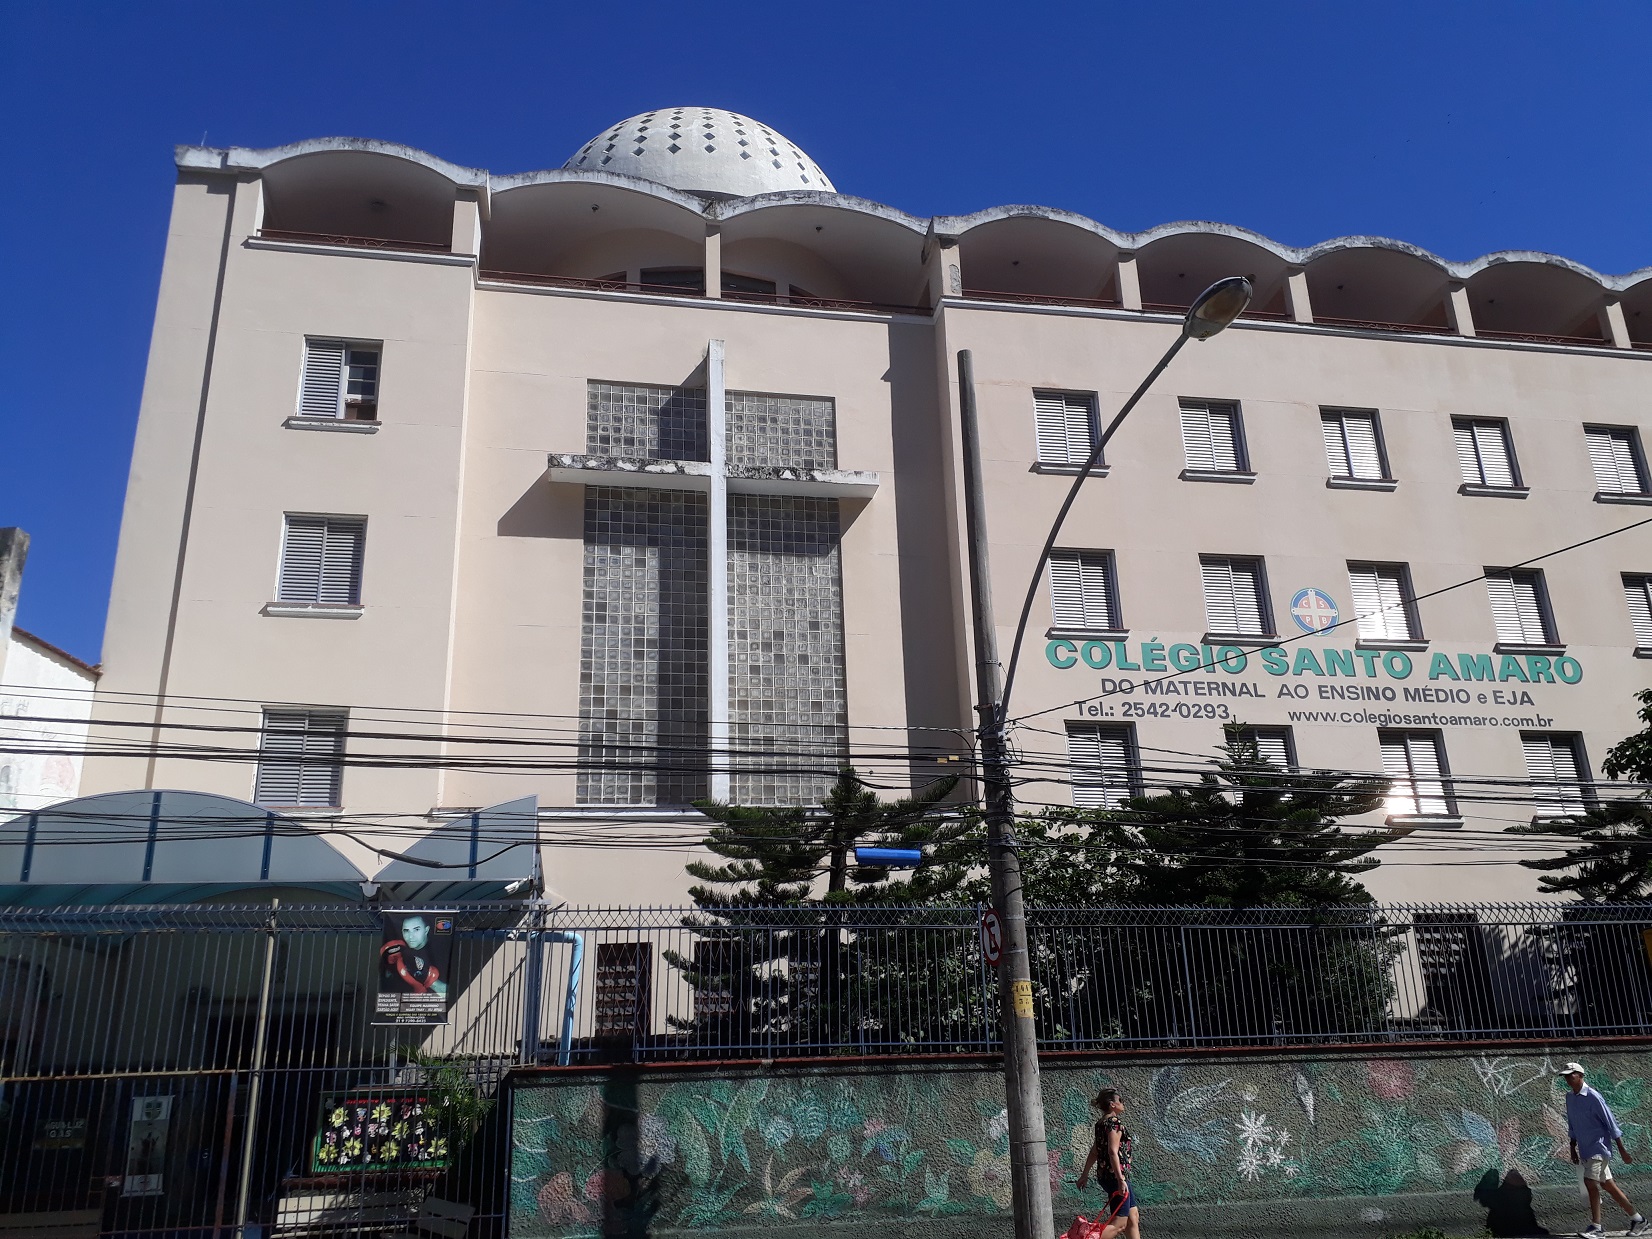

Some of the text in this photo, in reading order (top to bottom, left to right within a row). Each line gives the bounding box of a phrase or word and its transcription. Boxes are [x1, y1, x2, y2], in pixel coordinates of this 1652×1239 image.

[1302, 600, 1325, 608] C S
[1305, 616, 1328, 624] P B
[1045, 637, 1584, 685] COLÉGIO SANTO AMARO
[1101, 678, 1536, 706] DO MATERNAL AO ENSINO MÉDIO e EJA
[1074, 701, 1230, 719] Tel.: 2542-0293
[1288, 708, 1554, 727] www.colegiosantoamaro.com.br
